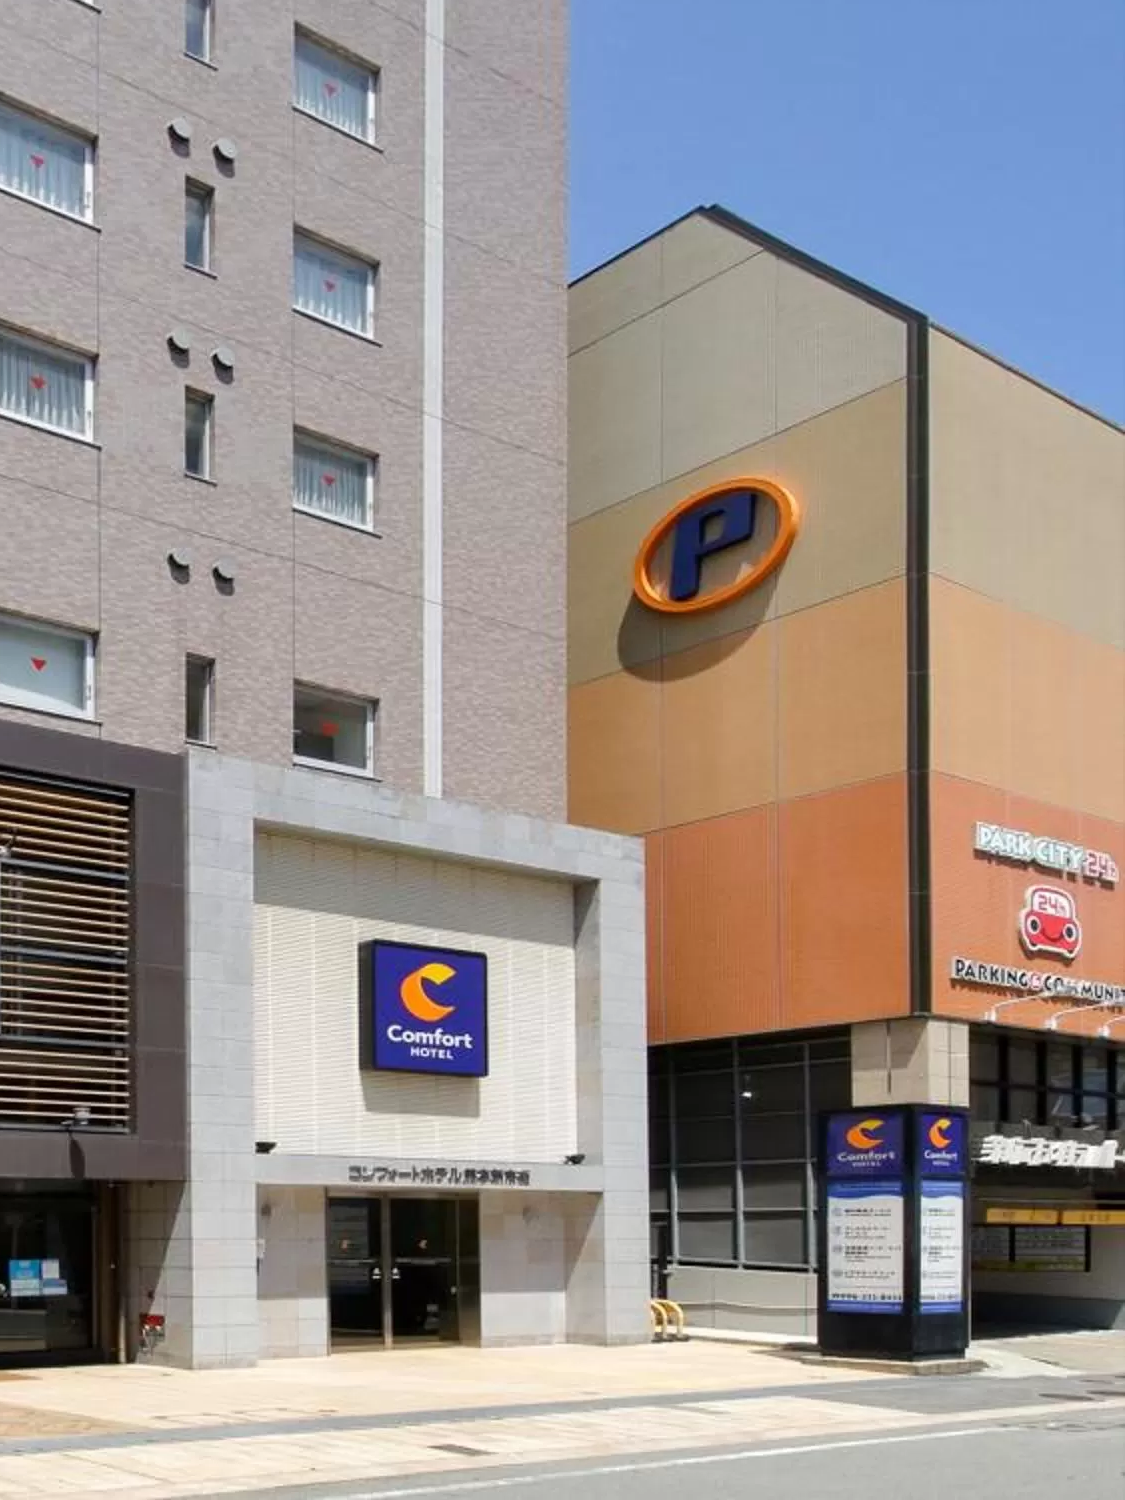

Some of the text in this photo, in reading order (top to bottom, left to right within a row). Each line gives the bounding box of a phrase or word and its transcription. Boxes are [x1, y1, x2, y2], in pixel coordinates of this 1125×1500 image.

[670, 492, 757, 602] P
[955, 959, 1029, 987] PARKING
[386, 1025, 473, 1049] Comfort
[410, 1046, 454, 1060] HOTEL
[837, 1150, 895, 1162] Comfort
